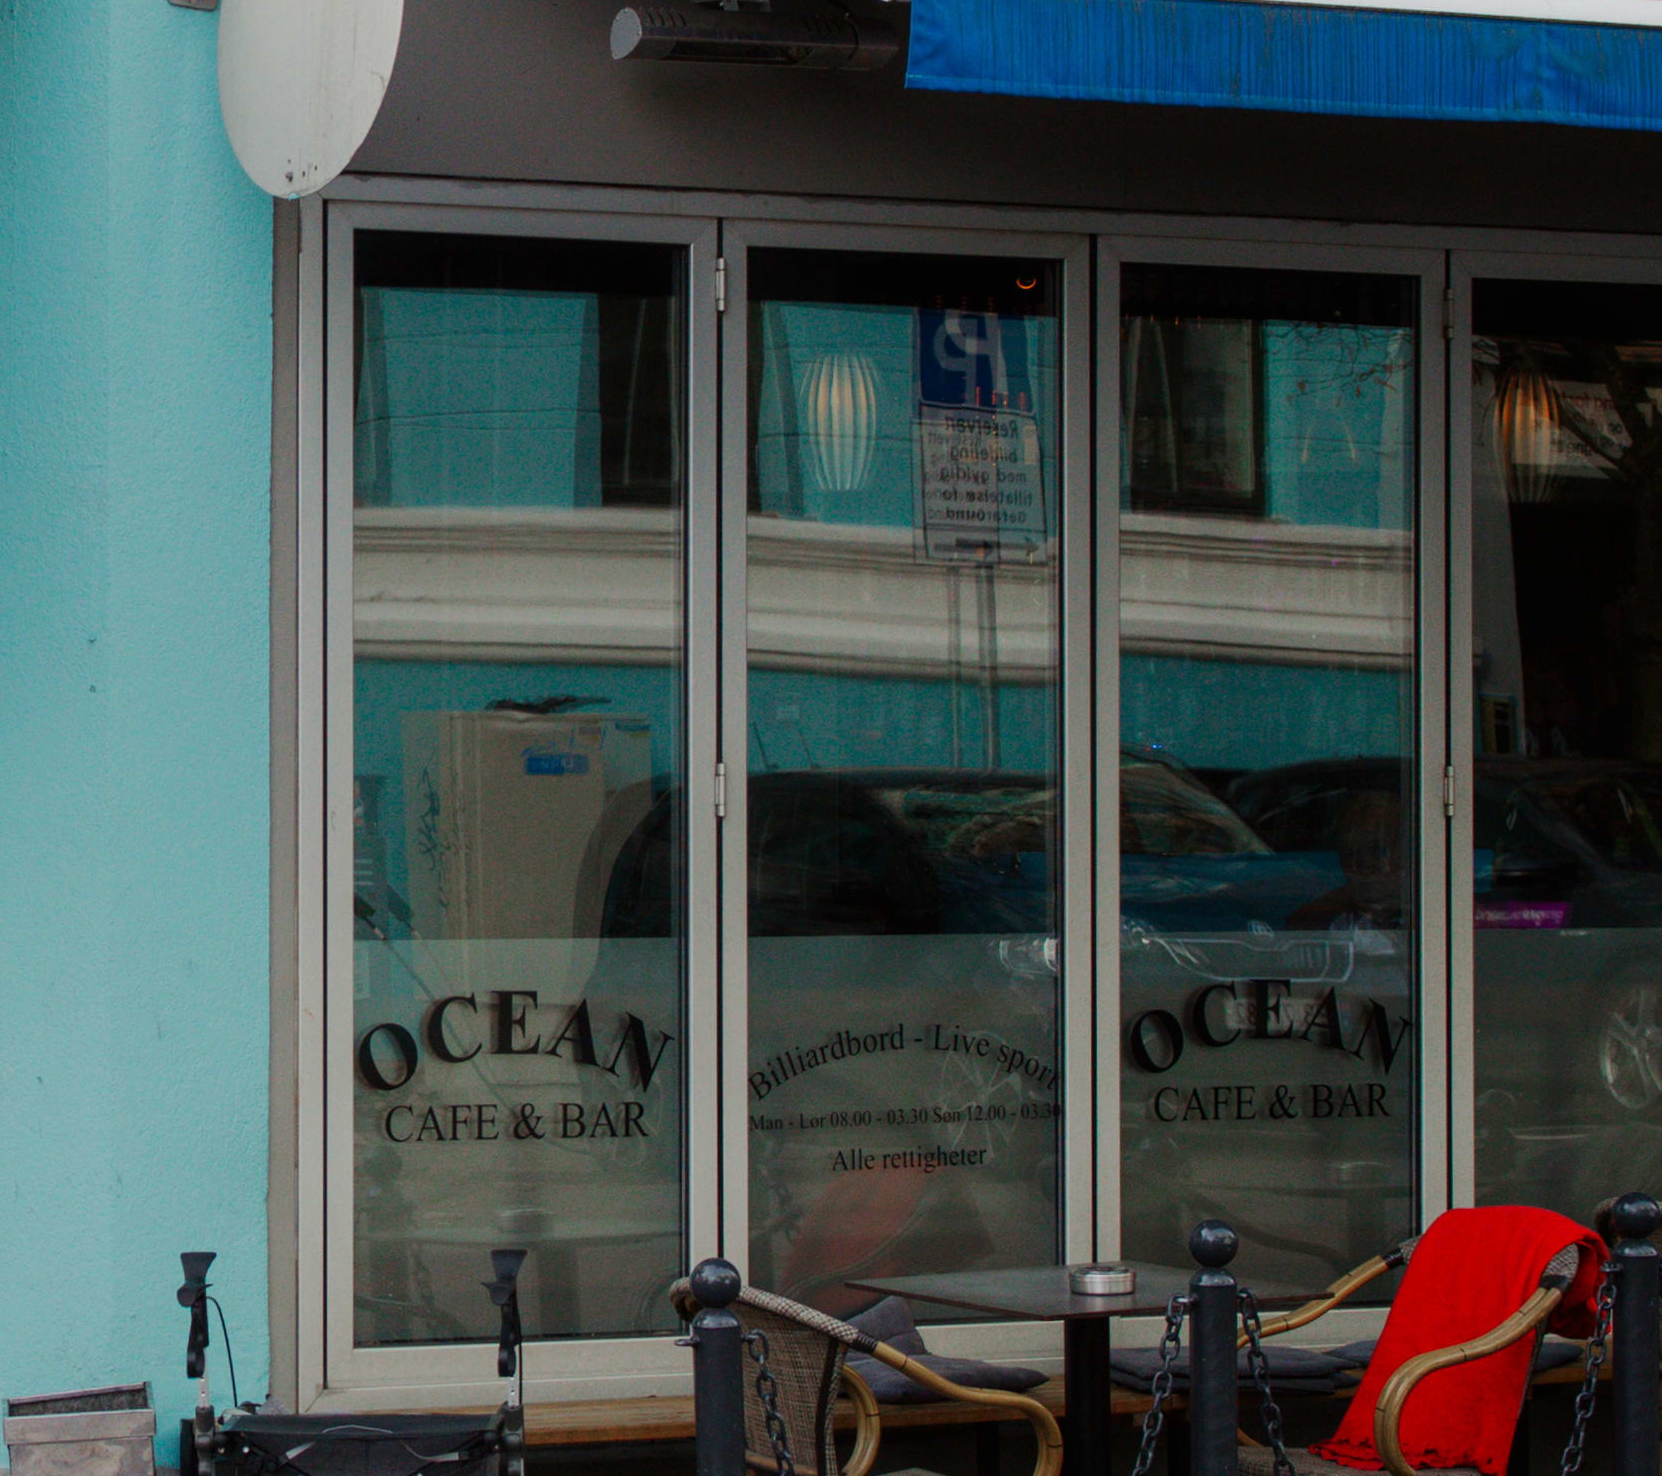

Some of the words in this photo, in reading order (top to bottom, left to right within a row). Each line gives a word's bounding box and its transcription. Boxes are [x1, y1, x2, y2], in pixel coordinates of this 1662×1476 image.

[359, 990, 674, 1093] OCEAN
[1132, 979, 1413, 1074] OCEAN
[748, 1023, 904, 1100] Billiardbord
[933, 1025, 990, 1056] Live
[997, 1042, 1059, 1090] sport
[385, 1103, 500, 1143] CAFE
[512, 1102, 545, 1140] &
[559, 1101, 649, 1140] BAR
[749, 1115, 783, 1131] Man
[829, 1110, 872, 1126] 08.00
[887, 1108, 928, 1124] 03.30
[933, 1107, 961, 1123] Søn
[967, 1104, 1006, 1121] 12.00
[1020, 1102, 1060, 1119] 03.30
[1155, 1086, 1256, 1122] CAFE
[1269, 1085, 1298, 1120] &
[1312, 1083, 1391, 1118] BAR
[832, 1149, 875, 1171] Alle
[882, 1145, 987, 1173] rettigheter
